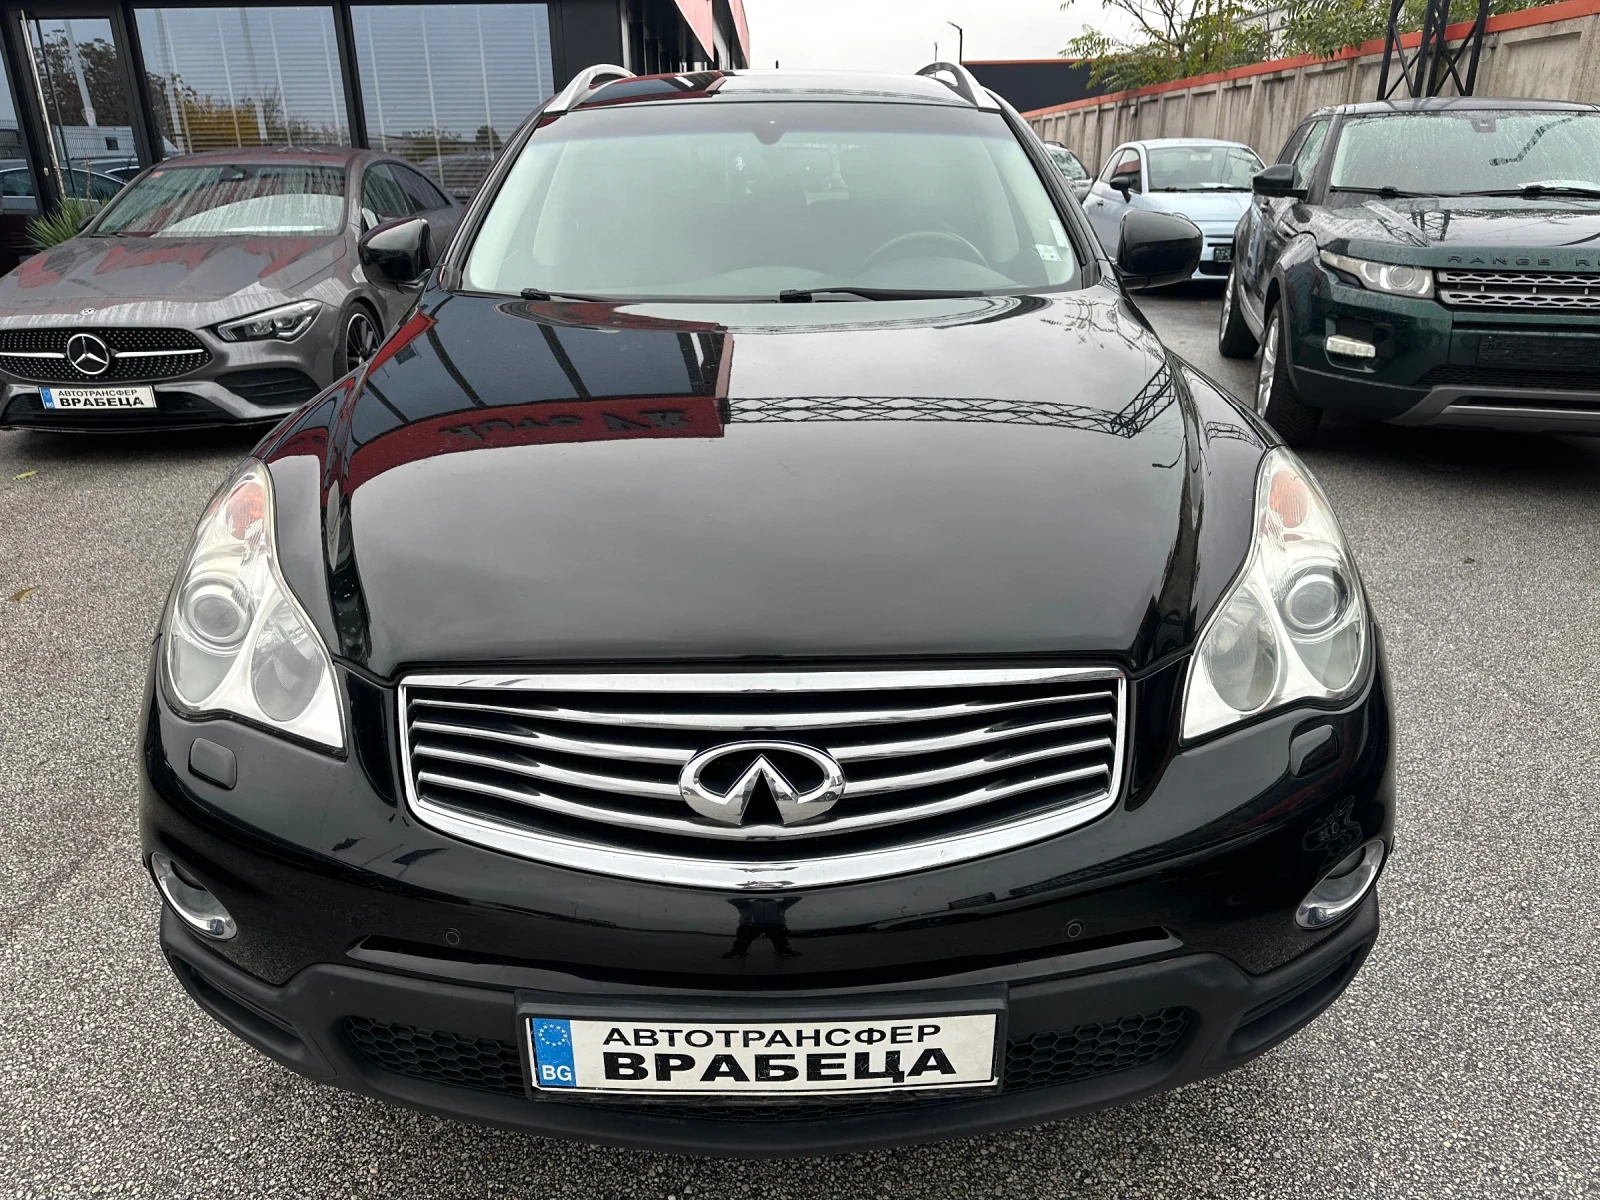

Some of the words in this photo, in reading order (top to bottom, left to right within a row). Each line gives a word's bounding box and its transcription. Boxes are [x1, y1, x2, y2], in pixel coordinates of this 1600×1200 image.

[1448, 256, 1550, 266] RANGE
[58, 389, 138, 397] АВТОТРАНСФЕР
[60, 397, 145, 407] ВРАБЕЦА
[602, 1024, 941, 1047] АВТОТРАНСФЕР
[603, 1047, 957, 1083] ВРАБЕЦА
[542, 1065, 573, 1081] BG
